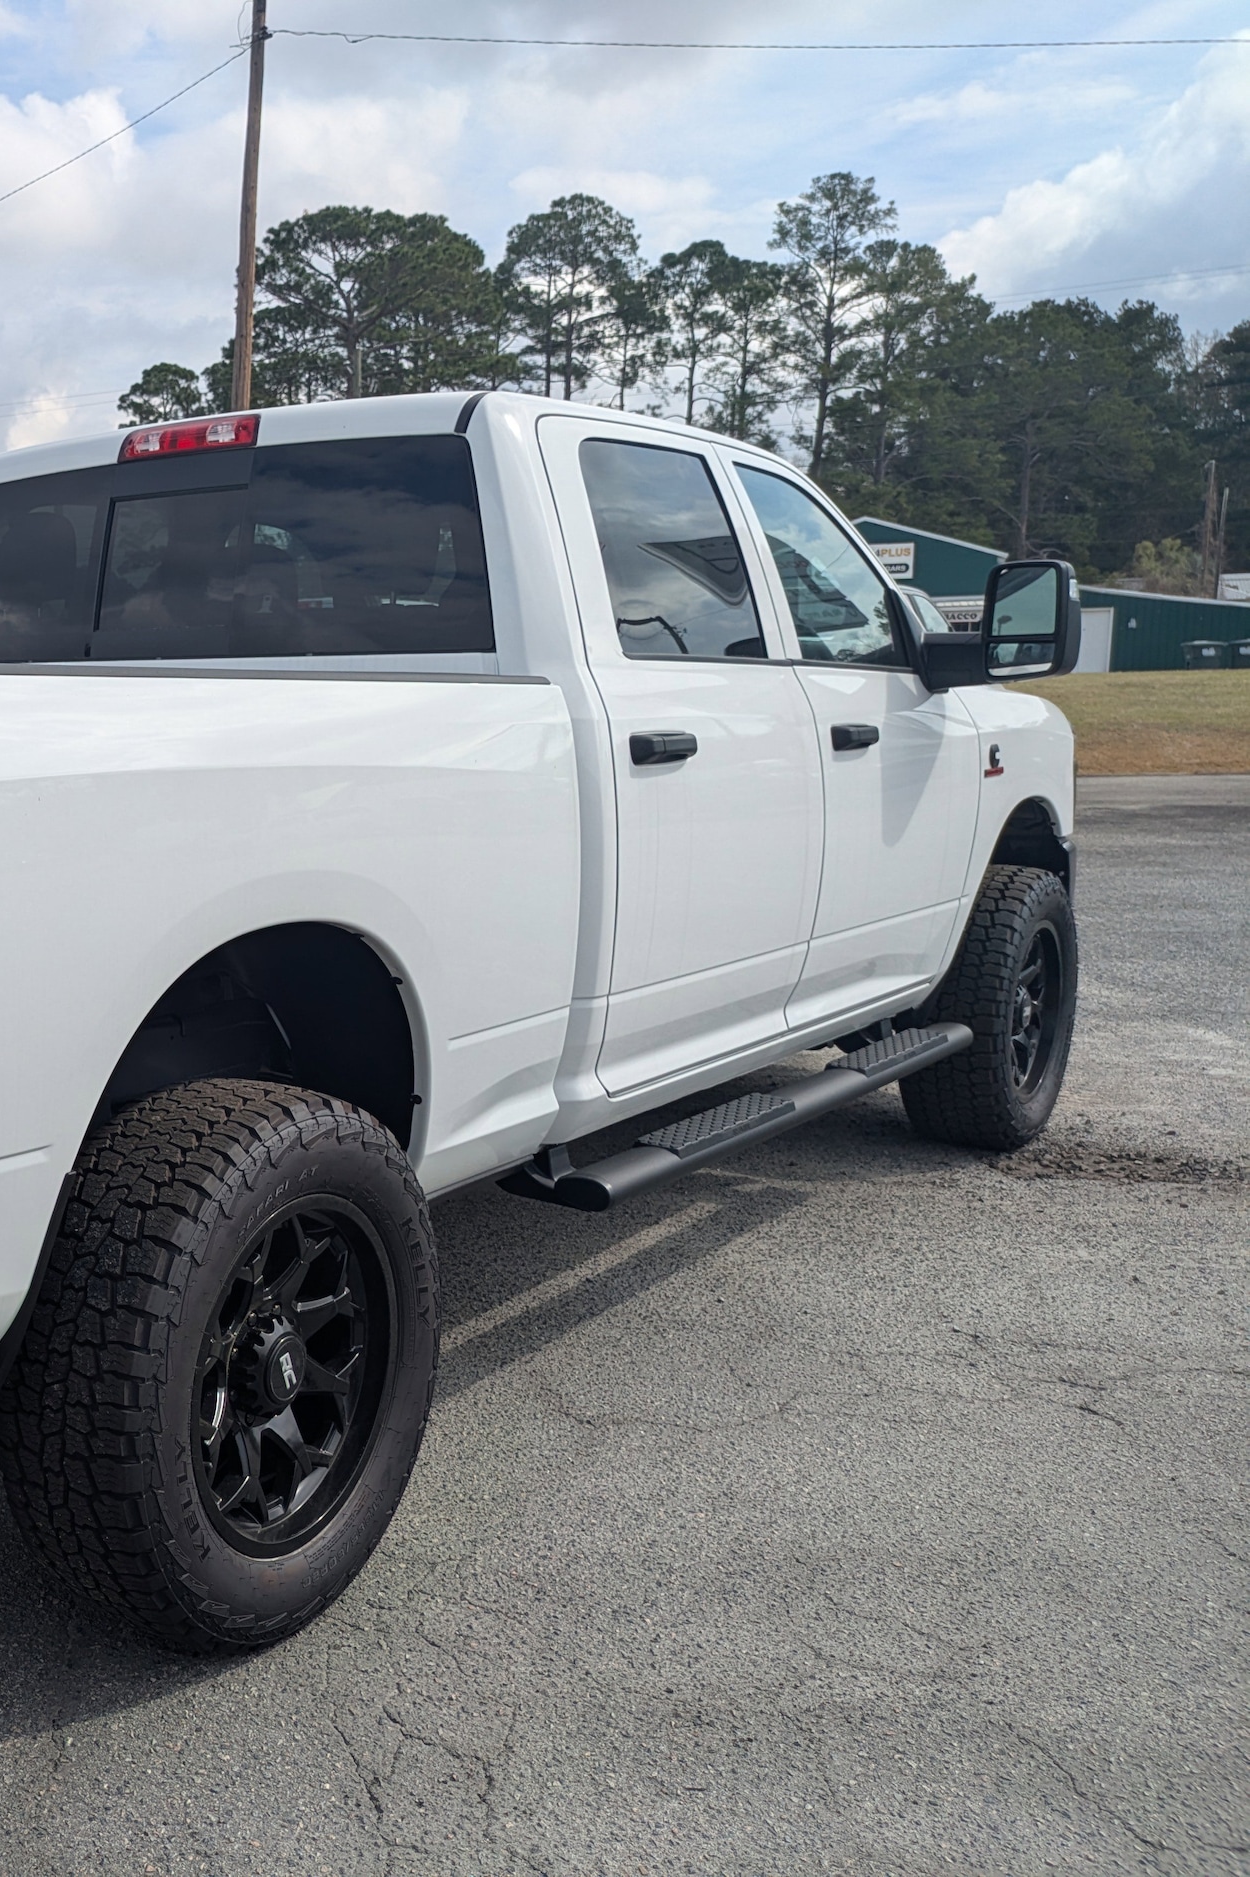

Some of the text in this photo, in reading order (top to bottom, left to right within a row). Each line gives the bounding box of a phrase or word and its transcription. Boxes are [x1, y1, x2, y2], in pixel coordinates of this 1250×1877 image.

[400, 1216, 433, 1330] KELLY
[279, 1351, 298, 1390] RC
[174, 1438, 211, 1563] KELLY
